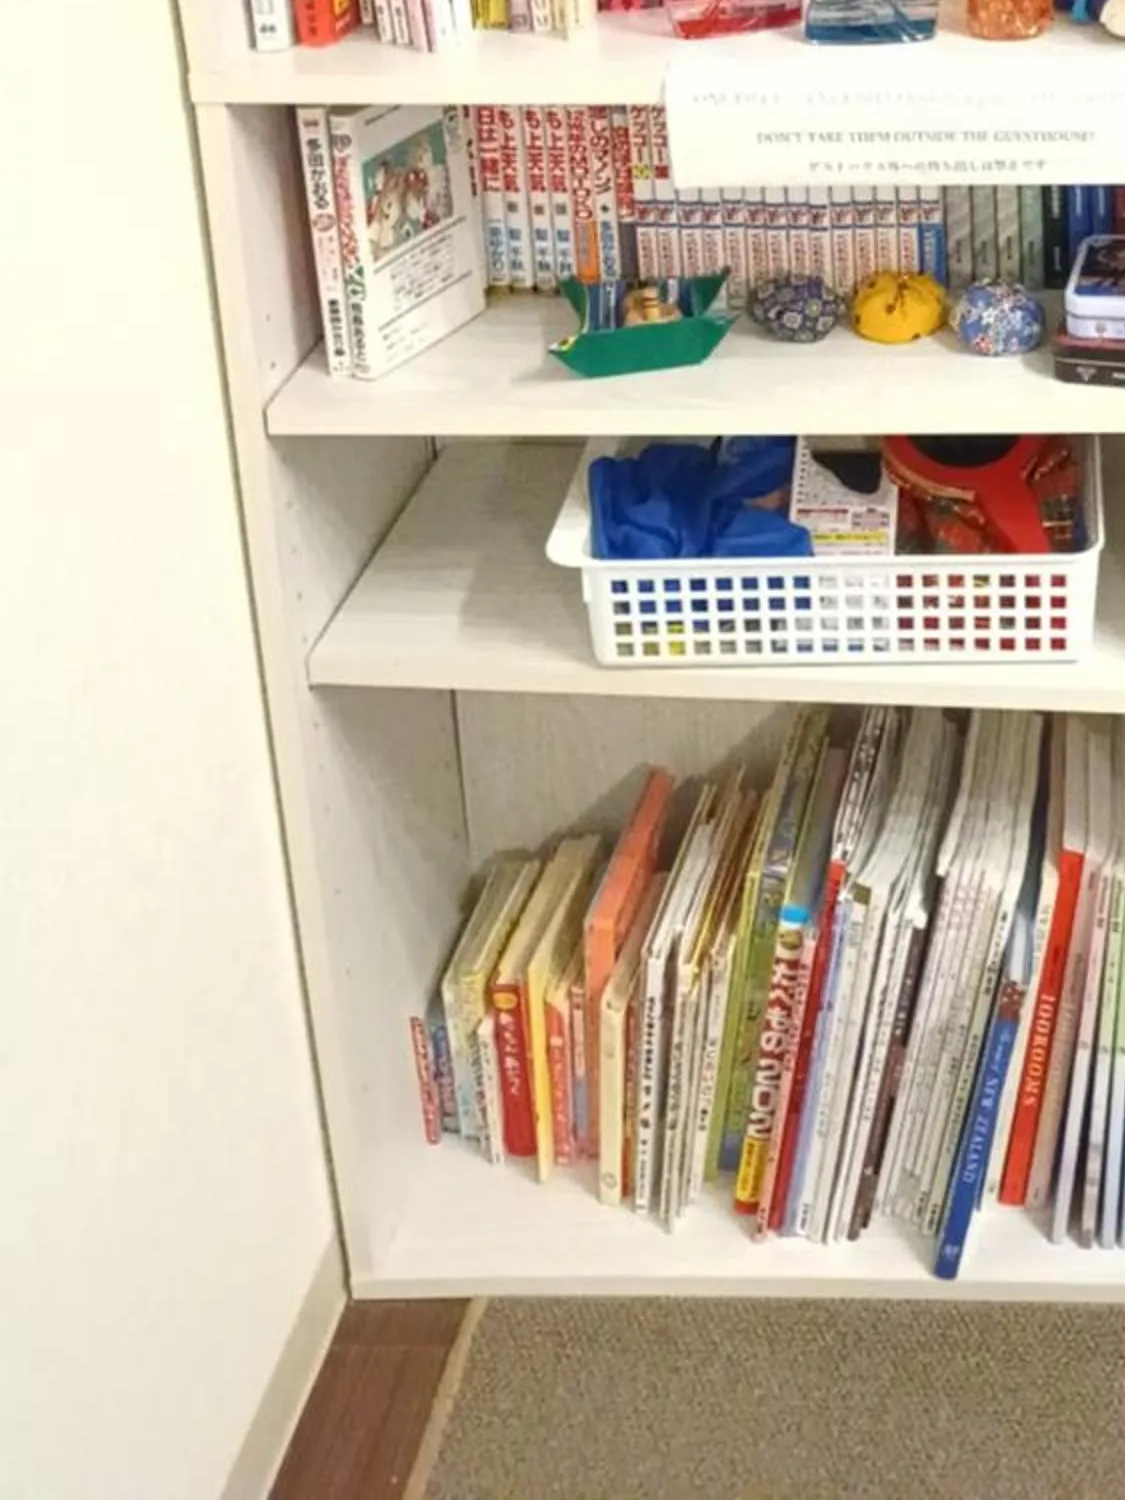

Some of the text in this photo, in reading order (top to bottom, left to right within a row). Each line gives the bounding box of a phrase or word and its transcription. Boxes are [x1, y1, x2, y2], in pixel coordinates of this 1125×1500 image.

[808, 131, 844, 144] TAKE
[849, 131, 891, 144] THEM
[894, 131, 958, 144] OUTSIDE
[962, 131, 988, 144] THE
